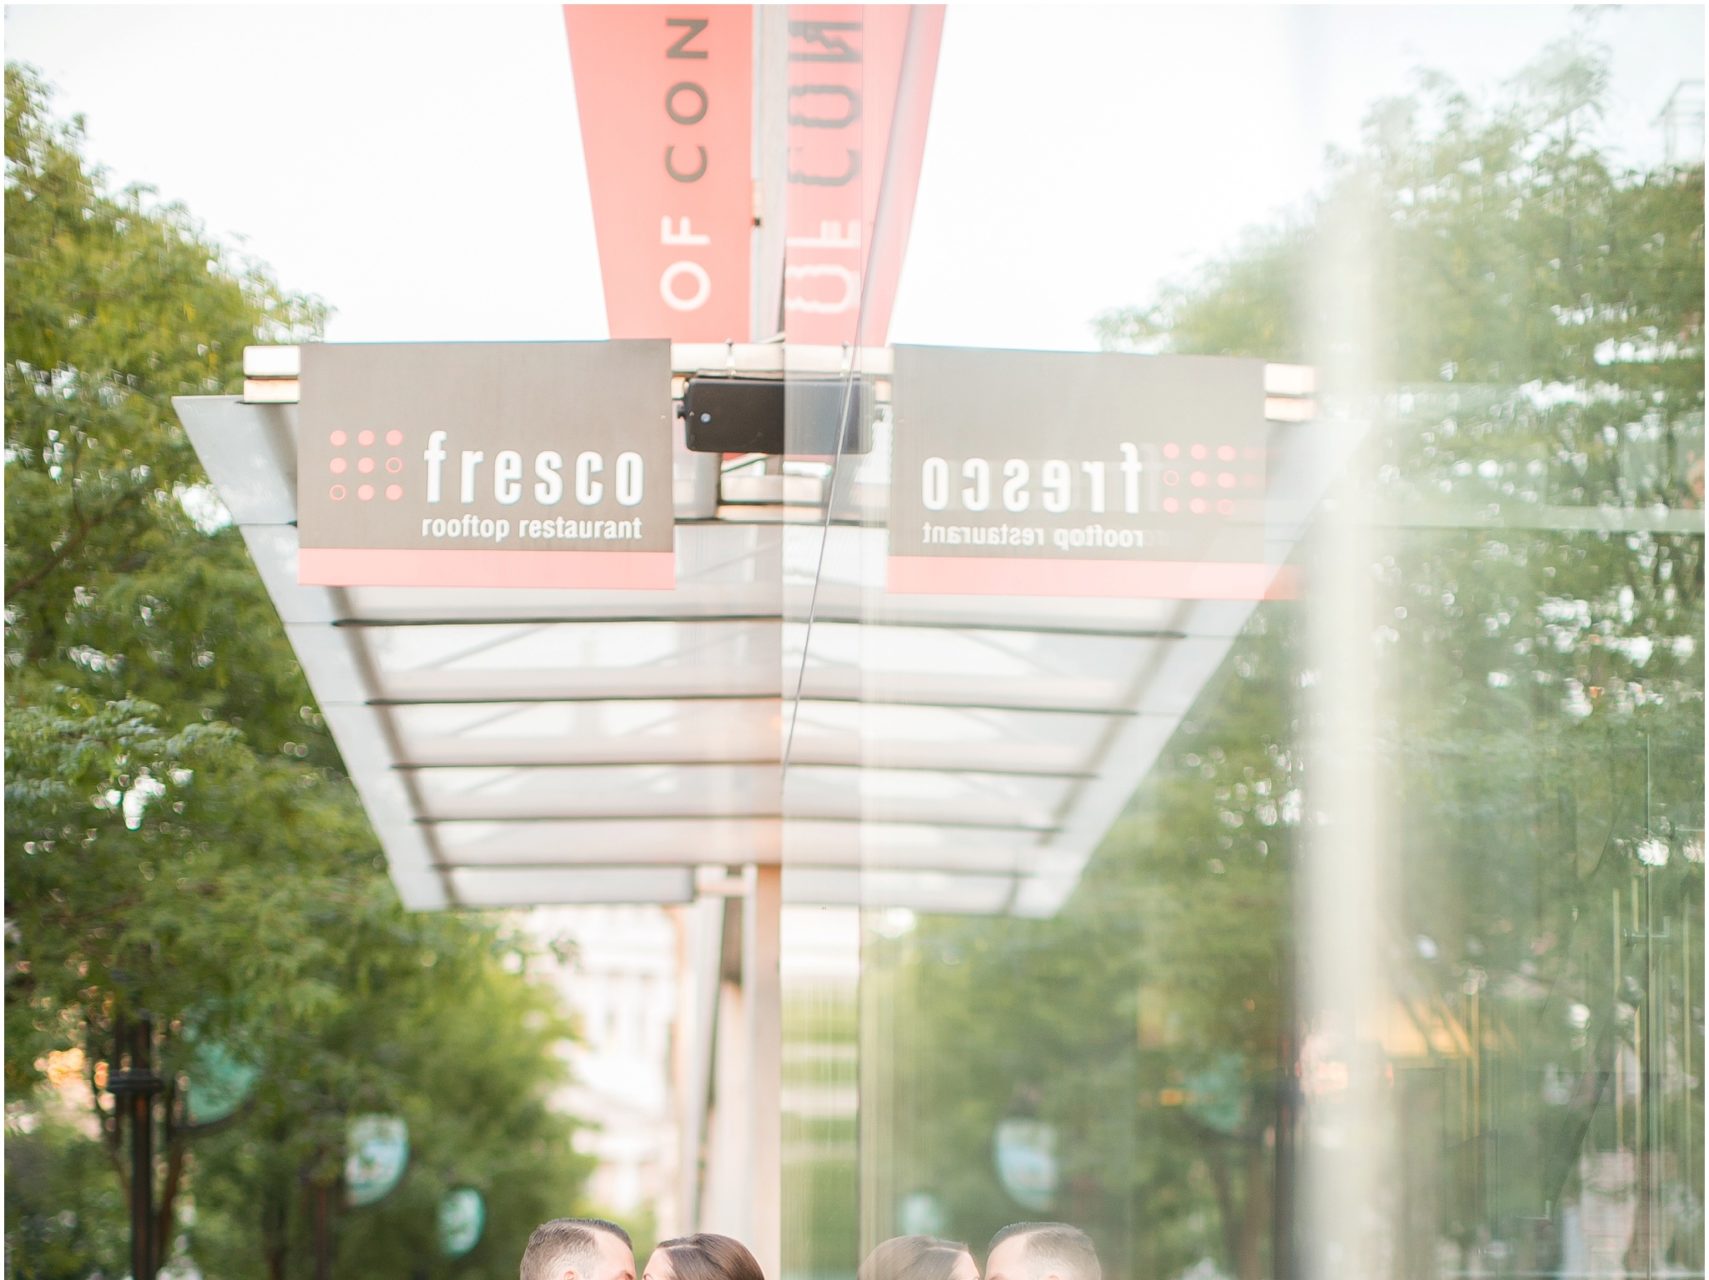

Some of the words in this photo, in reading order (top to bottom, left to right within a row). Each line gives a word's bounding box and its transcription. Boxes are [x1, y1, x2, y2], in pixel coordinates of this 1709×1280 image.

[664, 18, 709, 183] CON
[660, 215, 711, 311] OF
[424, 430, 644, 506] fresco
[422, 514, 510, 542] rooftop
[519, 516, 643, 540] restaurant
